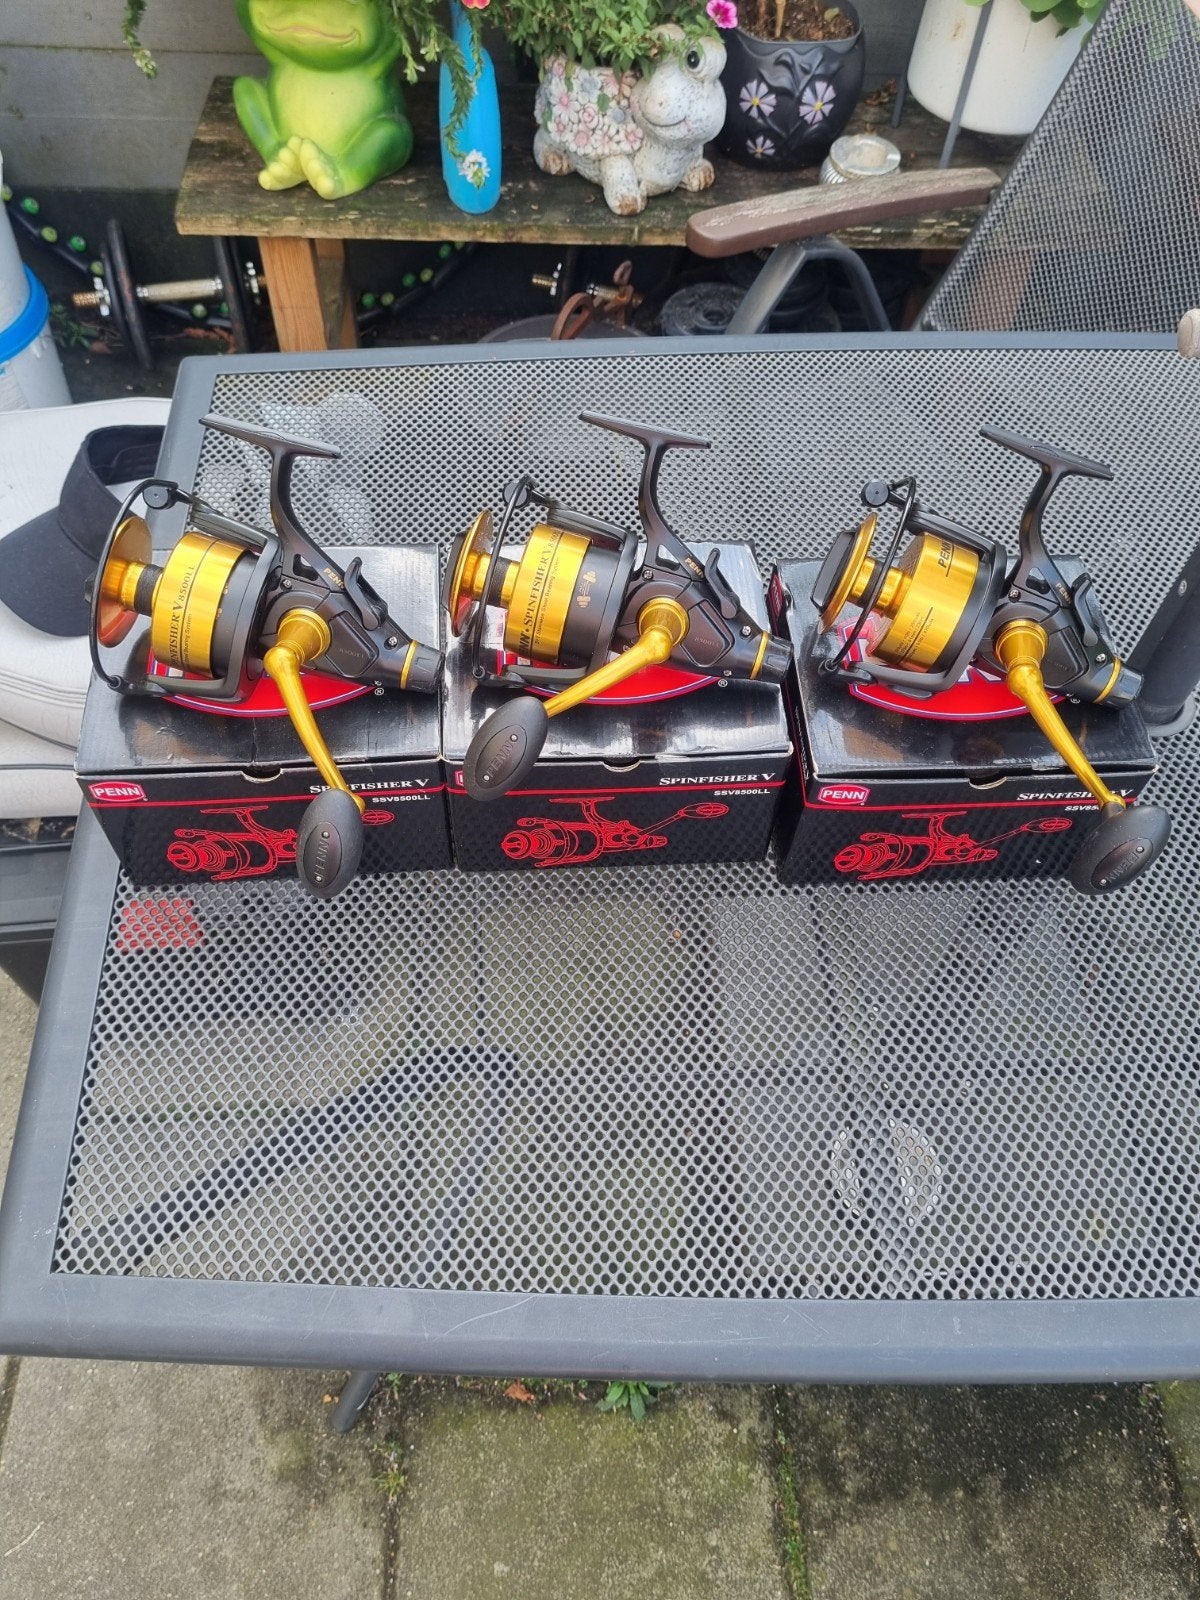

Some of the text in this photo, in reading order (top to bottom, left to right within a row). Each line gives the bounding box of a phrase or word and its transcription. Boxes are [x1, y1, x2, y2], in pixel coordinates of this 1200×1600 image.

[523, 556, 551, 628] SPINFISHER
[173, 600, 183, 611] V
[487, 740, 515, 778] PENN
[660, 772, 776, 786] SPINFISHER V
[94, 787, 140, 797] PENN
[309, 778, 430, 794] SPFISHER V
[713, 788, 771, 796] SSV8500LL
[822, 790, 866, 800] PENN
[1016, 788, 1134, 801] SPINFISH V
[1064, 804, 1099, 812] SSV85
